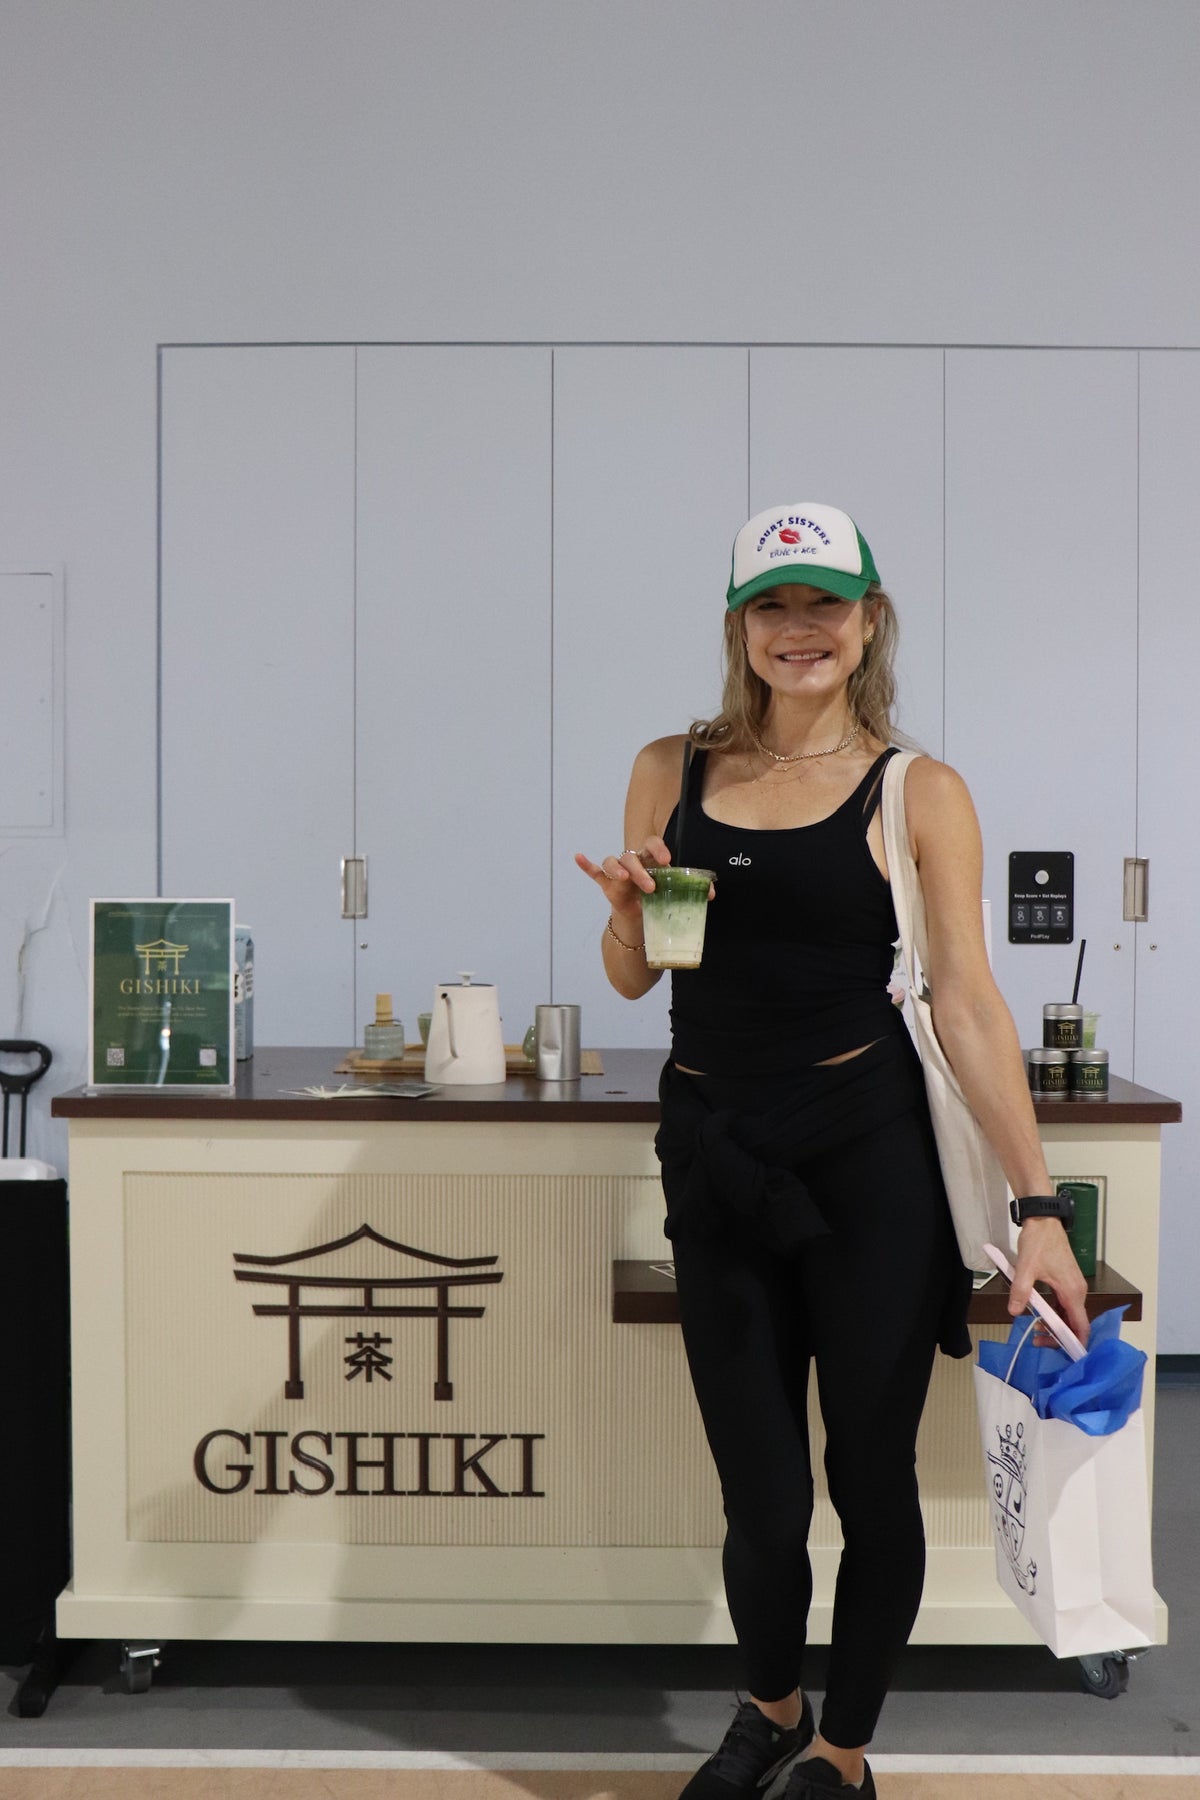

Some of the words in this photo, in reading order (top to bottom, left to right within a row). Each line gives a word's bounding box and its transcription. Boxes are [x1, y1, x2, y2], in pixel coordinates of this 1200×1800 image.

[757, 519, 784, 552] COURT
[788, 517, 831, 545] SISTERS
[728, 852, 752, 866] alo
[120, 979, 201, 994] GISHIKI
[344, 1332, 393, 1383] 茶
[193, 1428, 545, 1498] GISHIKI
